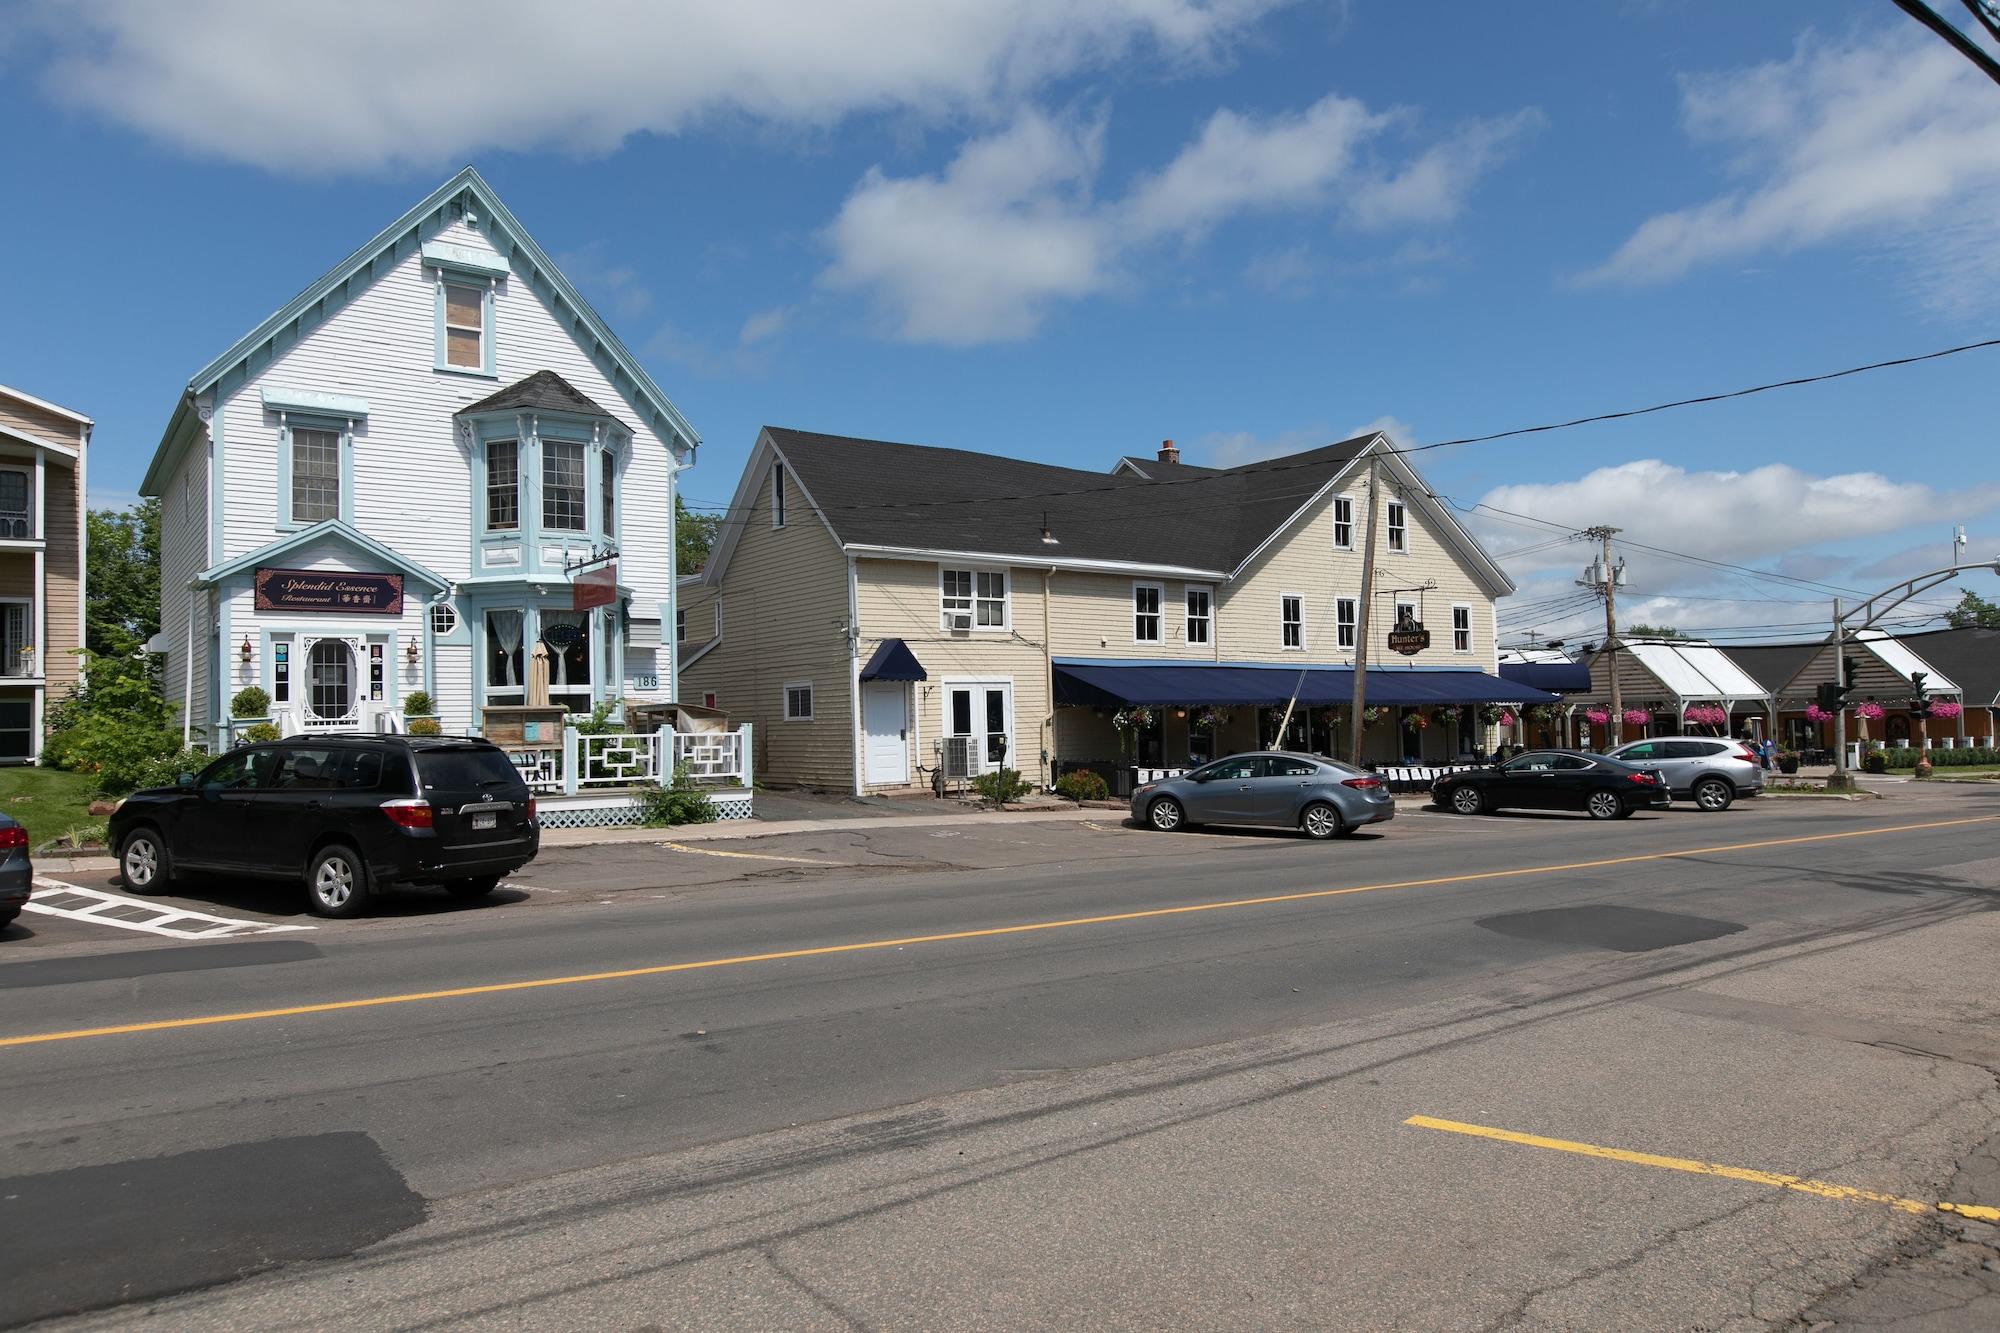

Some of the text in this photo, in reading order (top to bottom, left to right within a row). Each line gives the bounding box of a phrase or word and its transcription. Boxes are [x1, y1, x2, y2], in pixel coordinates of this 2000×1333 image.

[281, 579, 378, 592] Splendid Essence
[281, 594, 332, 603] Restaurant
[1391, 634, 1425, 643] Hunter's
[638, 676, 657, 687] 186
